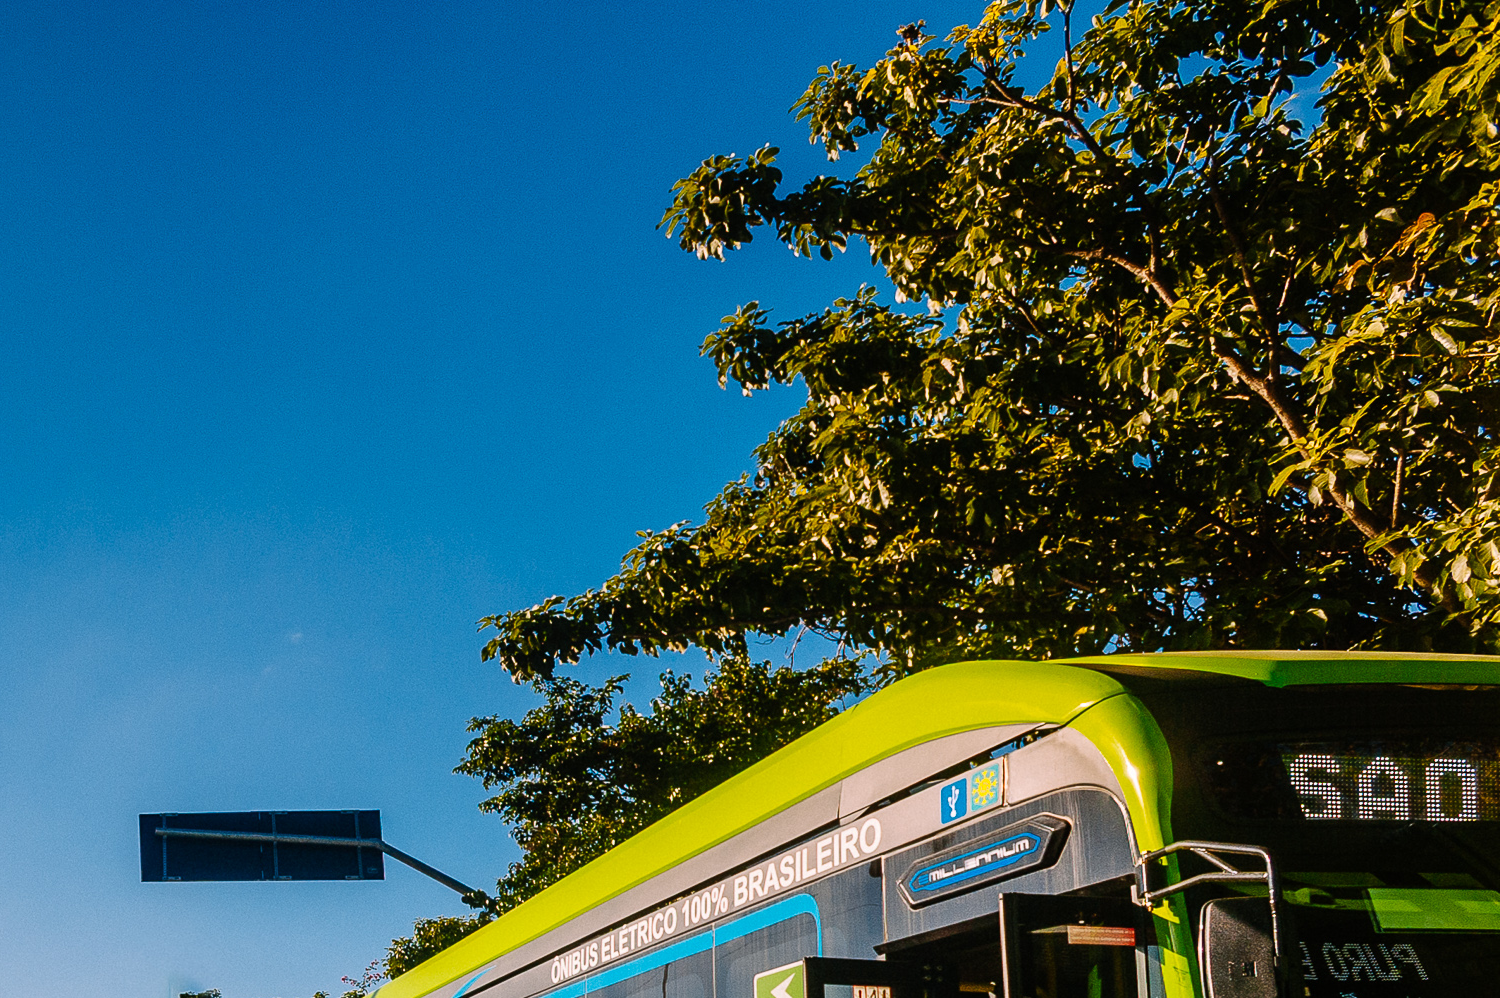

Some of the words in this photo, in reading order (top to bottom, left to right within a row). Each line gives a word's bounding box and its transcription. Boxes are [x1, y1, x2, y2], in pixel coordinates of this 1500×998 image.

[1289, 753, 1477, 822] SAO
[551, 942, 599, 984] ÔNIBUS
[600, 903, 677, 966] ELÉTRICO
[681, 884, 729, 927] 100%
[733, 817, 882, 907] BRASILEIRO
